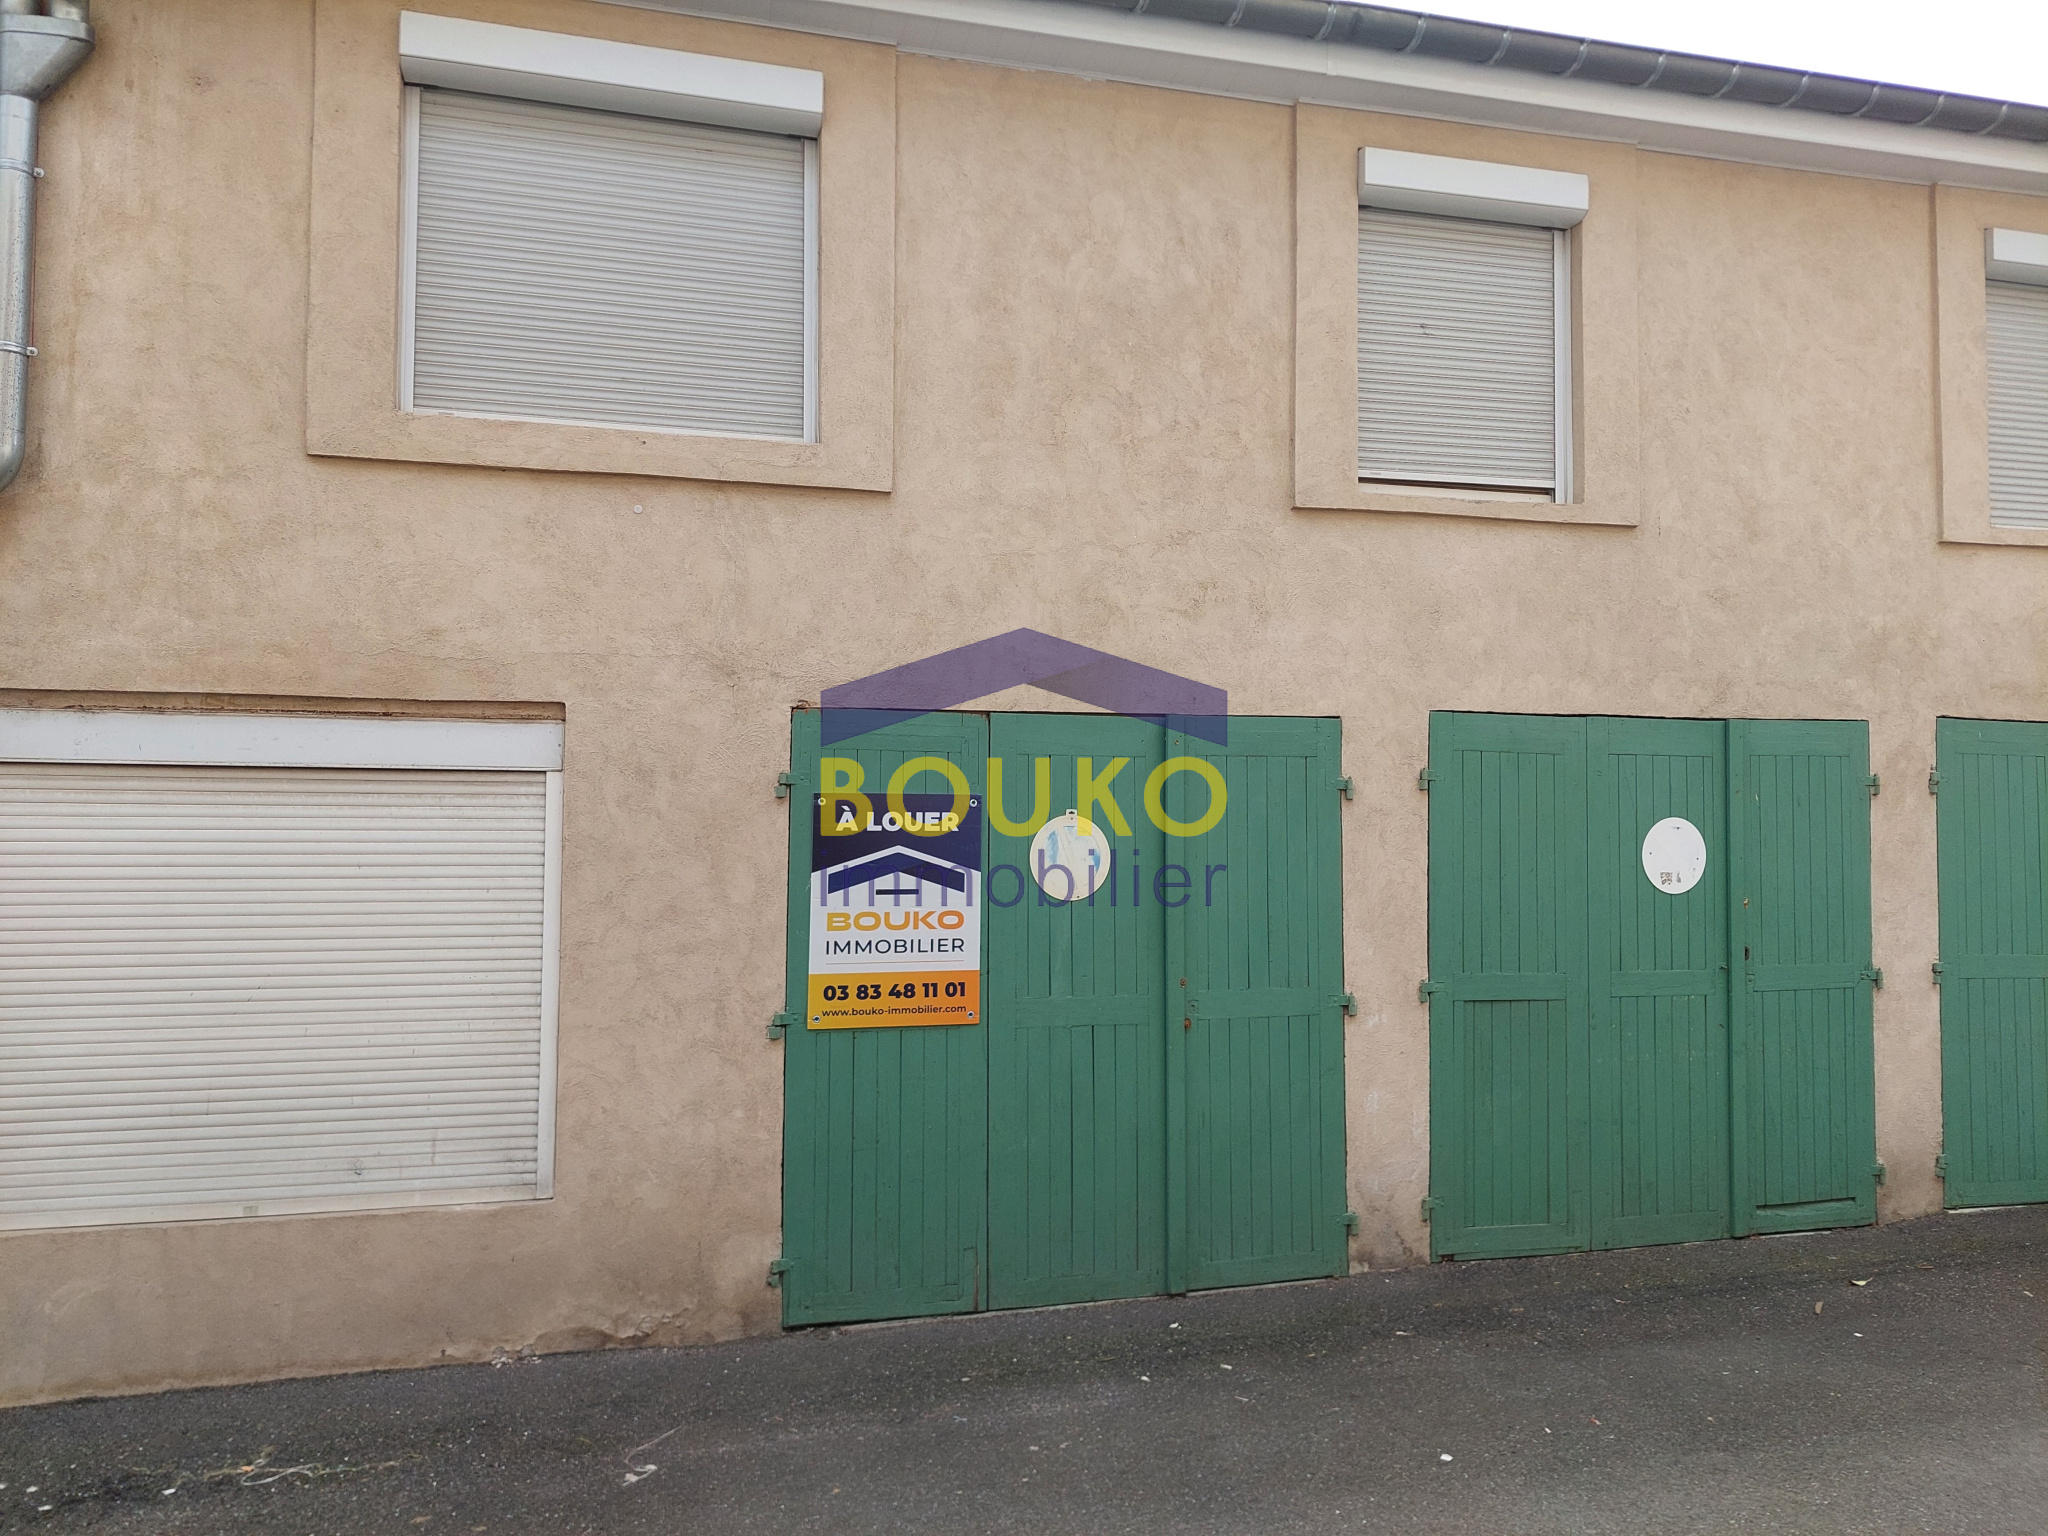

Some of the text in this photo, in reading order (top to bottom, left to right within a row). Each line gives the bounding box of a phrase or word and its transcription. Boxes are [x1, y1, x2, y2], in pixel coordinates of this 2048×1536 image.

[835, 805, 960, 832] À LOUER
[826, 910, 965, 932] BOUKO
[826, 937, 965, 955] IMMOBILIER
[823, 981, 966, 1001] 03 83 48 11 01
[822, 1004, 967, 1017] www.bouko-immobilier.com
